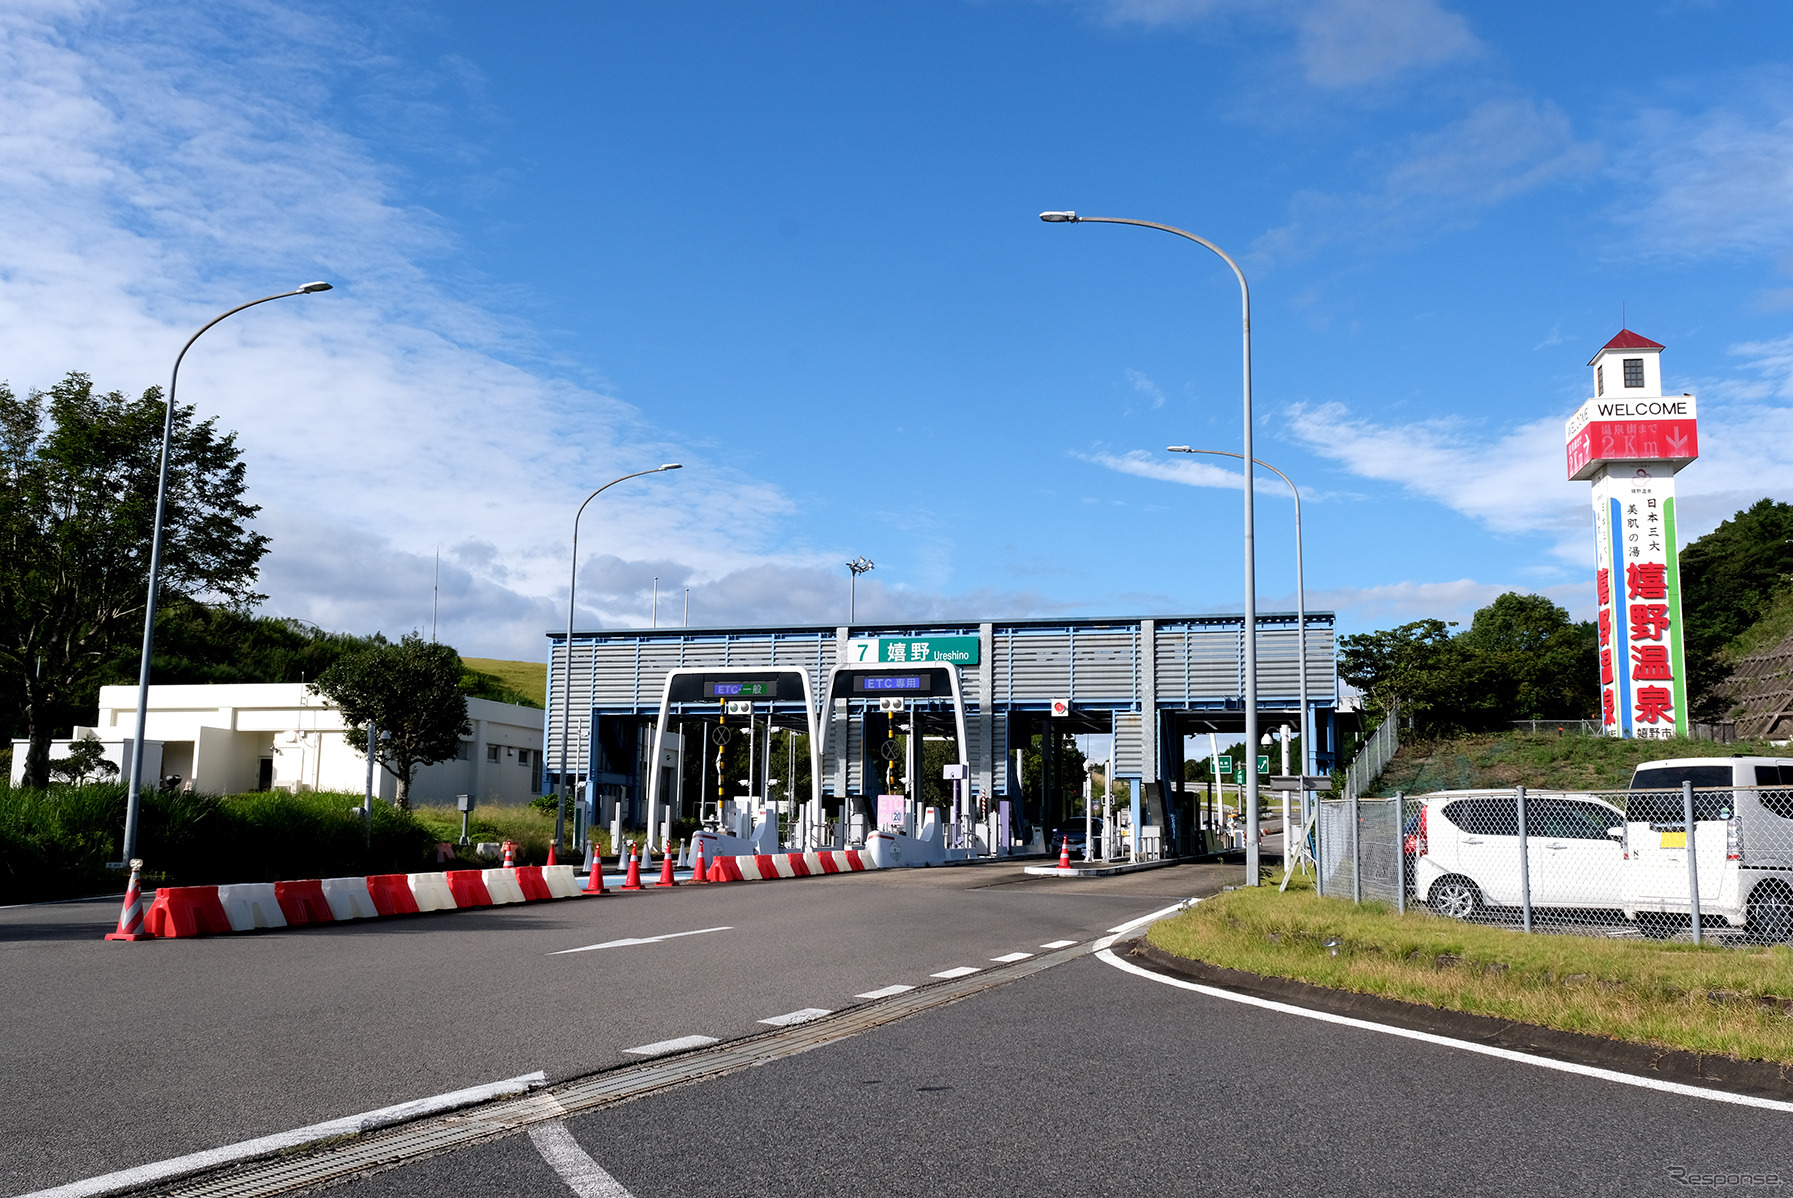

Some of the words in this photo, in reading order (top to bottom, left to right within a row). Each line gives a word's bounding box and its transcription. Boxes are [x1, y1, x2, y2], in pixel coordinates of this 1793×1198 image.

[1597, 402, 1688, 416] WELCOME
[1601, 424, 1658, 436] 温泉街まで
[1627, 504, 1640, 557] 美肌の湯
[1647, 498, 1661, 552] 日本三大
[1626, 561, 1674, 724] 嬉野温泉
[857, 644, 869, 662] 7
[887, 642, 930, 662] 嬉野
[933, 650, 970, 661] Ureshino
[867, 678, 893, 689] ETC
[895, 678, 916, 688] 専用
[893, 812, 902, 821] 20
